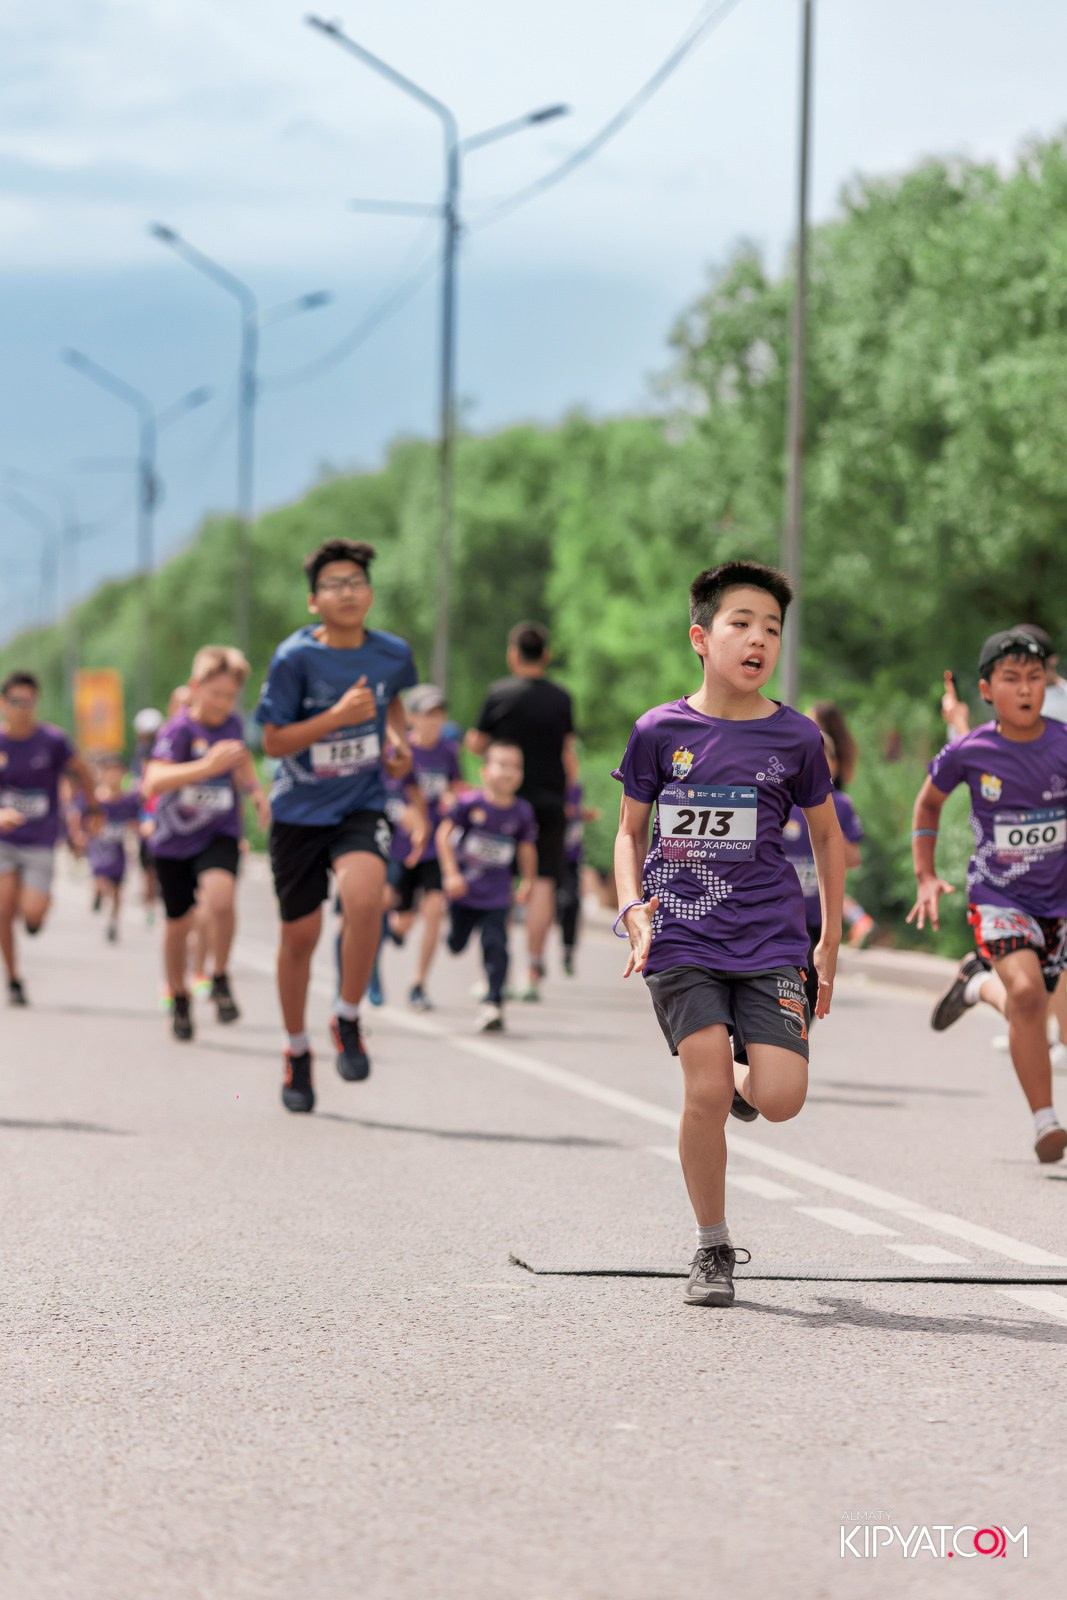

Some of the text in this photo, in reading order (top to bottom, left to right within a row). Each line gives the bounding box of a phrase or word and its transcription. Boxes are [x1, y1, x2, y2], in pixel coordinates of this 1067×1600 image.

[671, 809, 735, 837] 213
[1008, 826, 1057, 846] 060
[702, 841, 752, 850] ЖАРЫСЫ
[686, 849, 707, 858] 600
[777, 980, 800, 991] LOTS
